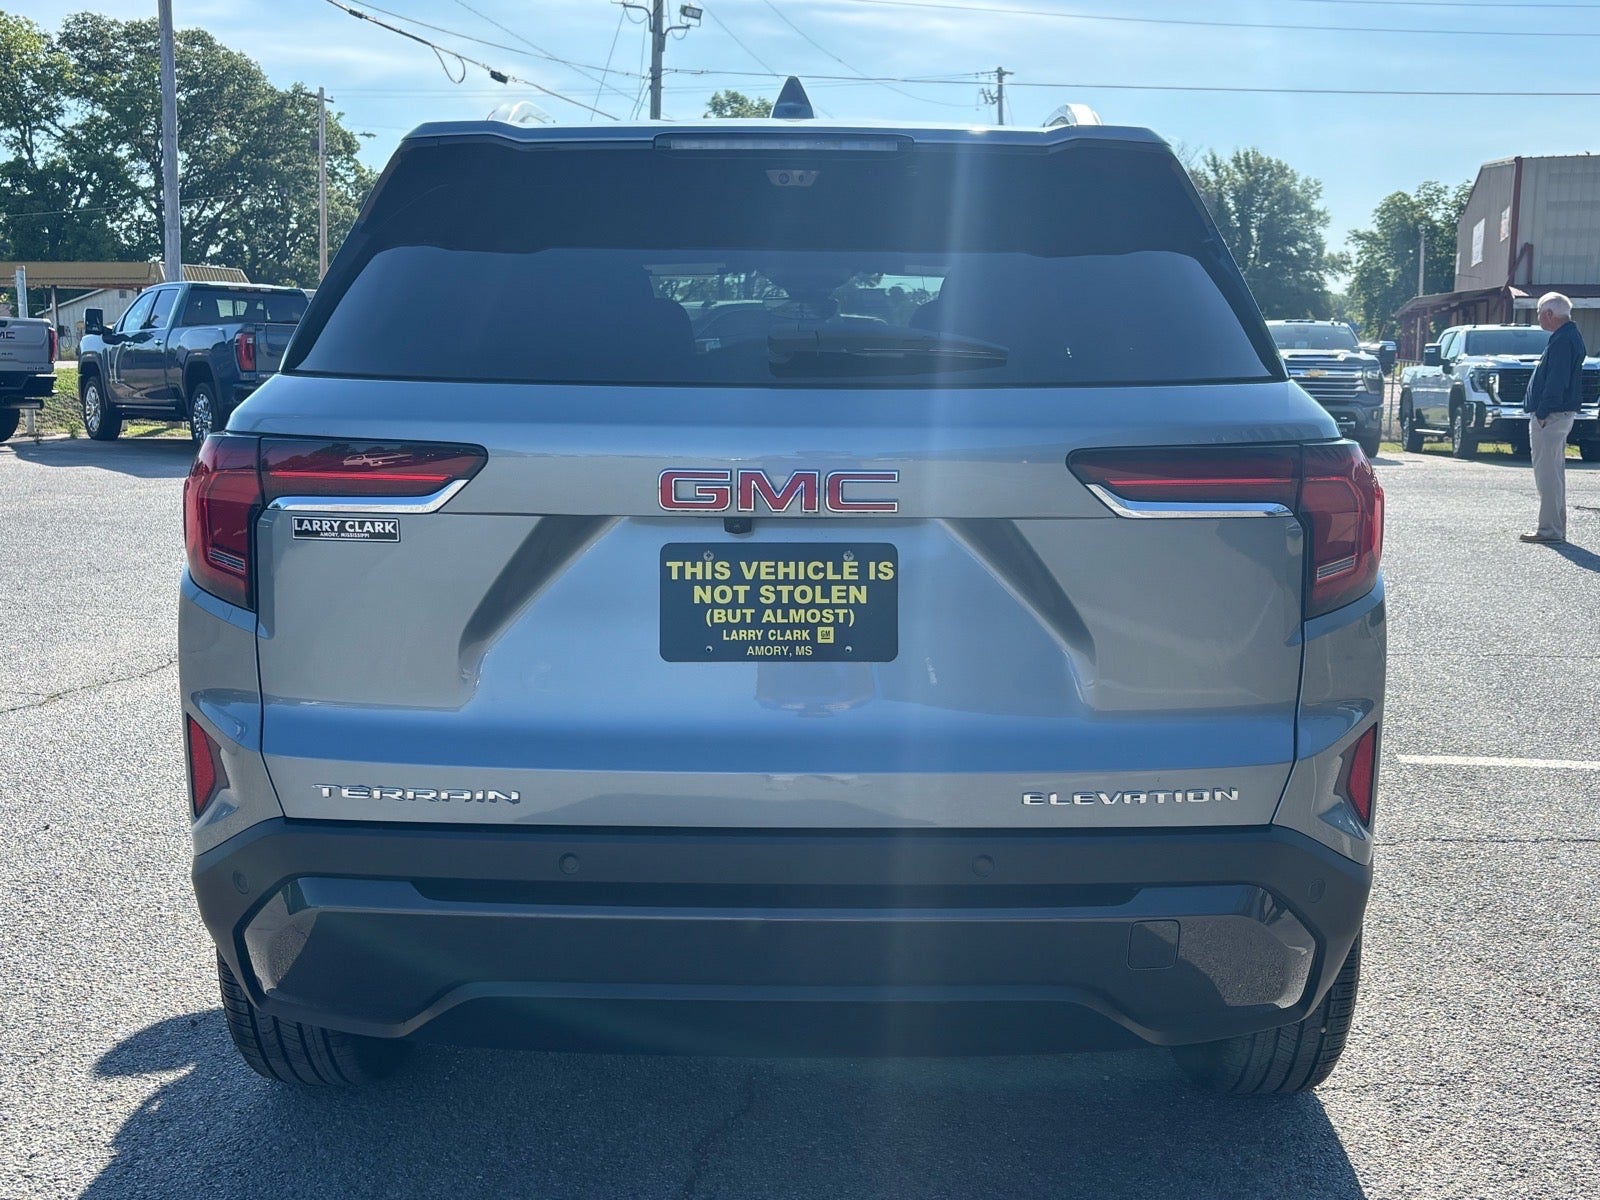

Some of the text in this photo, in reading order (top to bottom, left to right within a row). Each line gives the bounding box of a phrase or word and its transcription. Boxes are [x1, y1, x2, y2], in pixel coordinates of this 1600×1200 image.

[658, 469, 899, 513] GMC
[294, 519, 396, 533] LARRY CLARK
[666, 561, 894, 580] THIS VEHICLE IS
[693, 585, 867, 604] NOT STOLEN
[705, 609, 855, 627] (BUT ALMOST)
[722, 629, 810, 640] LARRY CLARK
[746, 646, 813, 657] AMORY, MS
[311, 783, 520, 805] TERRAIN
[1021, 787, 1239, 806] ELEVATION
